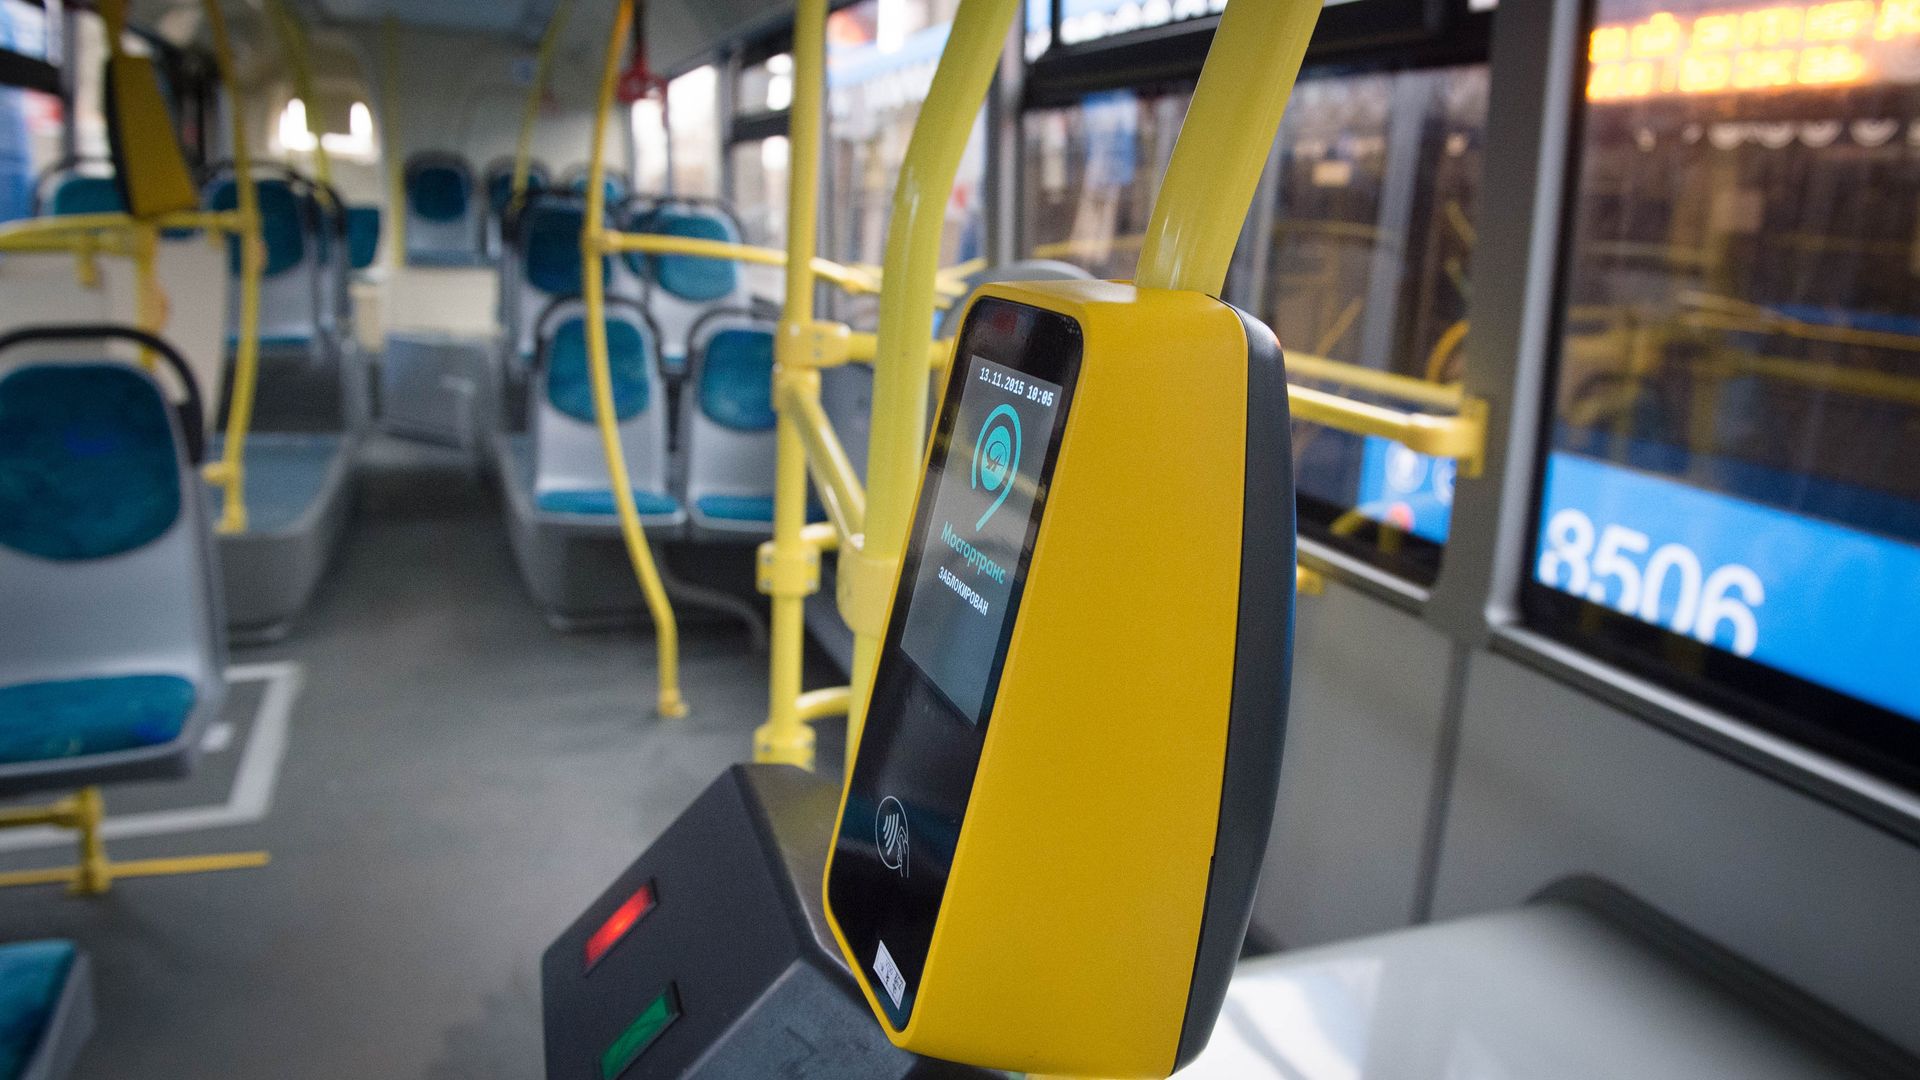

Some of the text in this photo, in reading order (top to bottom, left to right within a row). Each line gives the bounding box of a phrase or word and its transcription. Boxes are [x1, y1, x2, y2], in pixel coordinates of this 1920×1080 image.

[979, 366, 1054, 408] 13.11.2015 10:05
[941, 520, 1006, 584] Мосгортранс
[938, 566, 989, 616] ЗАБЛОКИРОВАН
[1538, 508, 1765, 658] 8506
